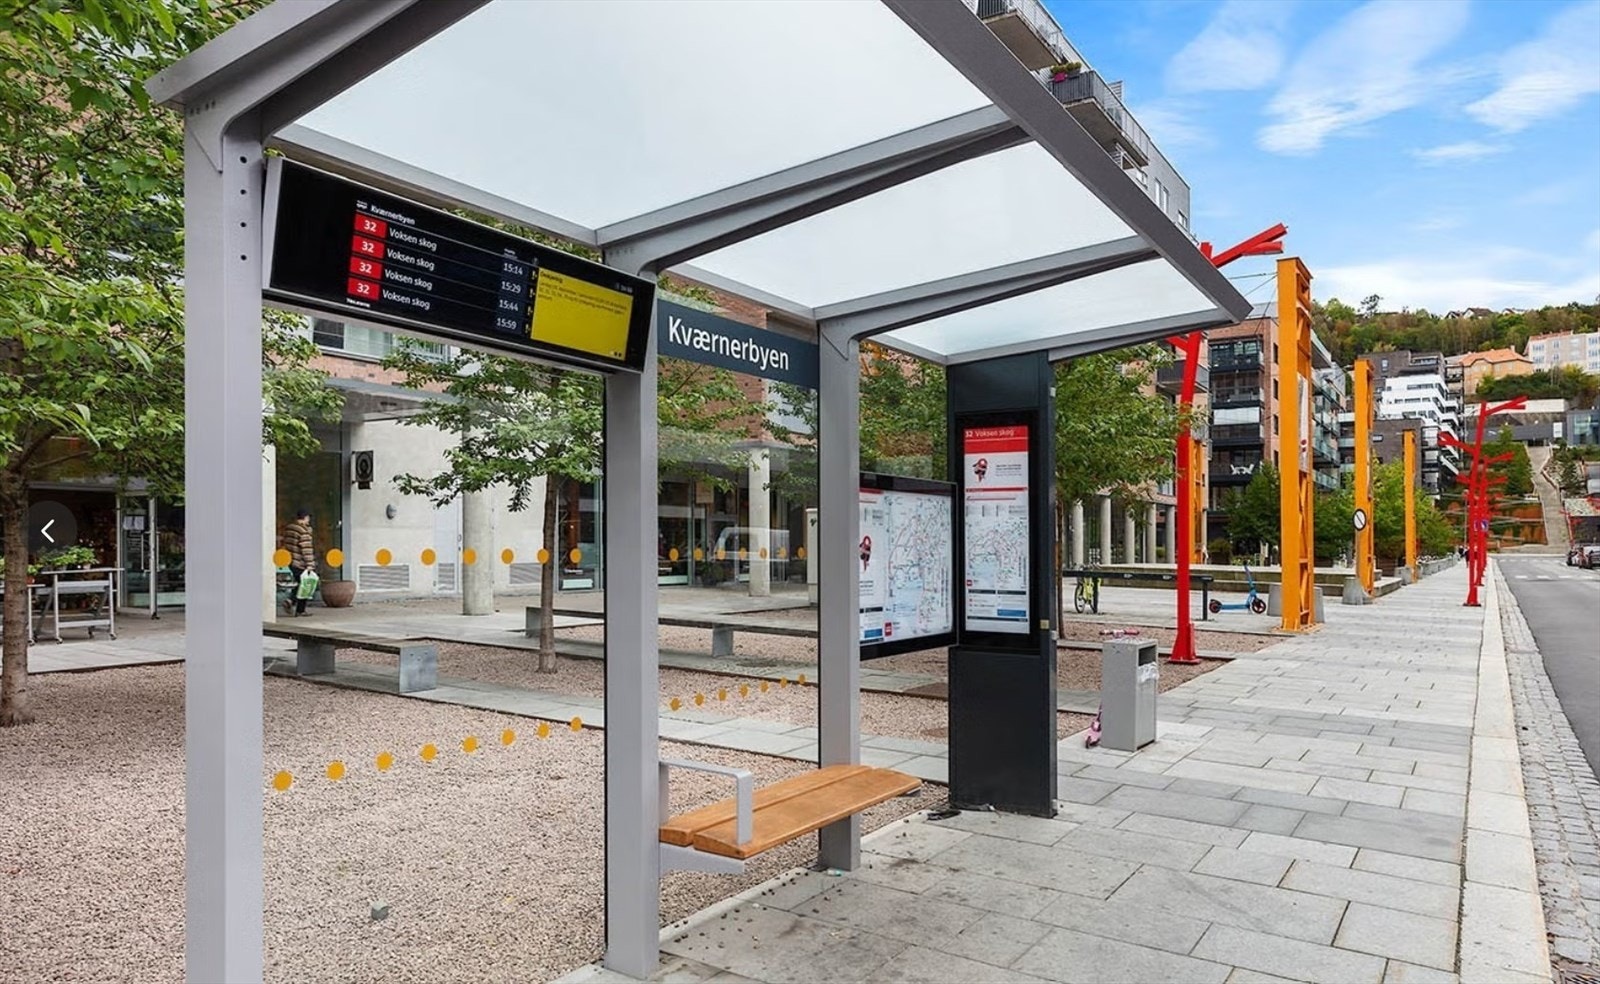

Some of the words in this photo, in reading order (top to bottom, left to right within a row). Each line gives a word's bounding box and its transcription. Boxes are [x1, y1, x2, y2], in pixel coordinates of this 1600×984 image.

[370, 205, 416, 225] Kværnerbyen
[364, 220, 377, 232] 32
[389, 227, 418, 244] Voksen
[418, 238, 438, 252] skog
[361, 241, 375, 253] 32
[386, 248, 415, 264] Voksen
[416, 258, 435, 271] skog
[359, 262, 372, 274] 32
[384, 269, 413, 284] Voksen
[414, 278, 433, 291] skog
[503, 262, 523, 275] 15:14
[357, 283, 370, 295] 32
[382, 289, 411, 304] Voksen
[411, 298, 431, 311] skog
[501, 281, 522, 294] 15:29
[499, 299, 519, 312] 15:44
[496, 317, 517, 330] 15:59
[668, 315, 790, 371] Kværnerbyen
[965, 430, 973, 438] 32
[999, 429, 1014, 437] skog
